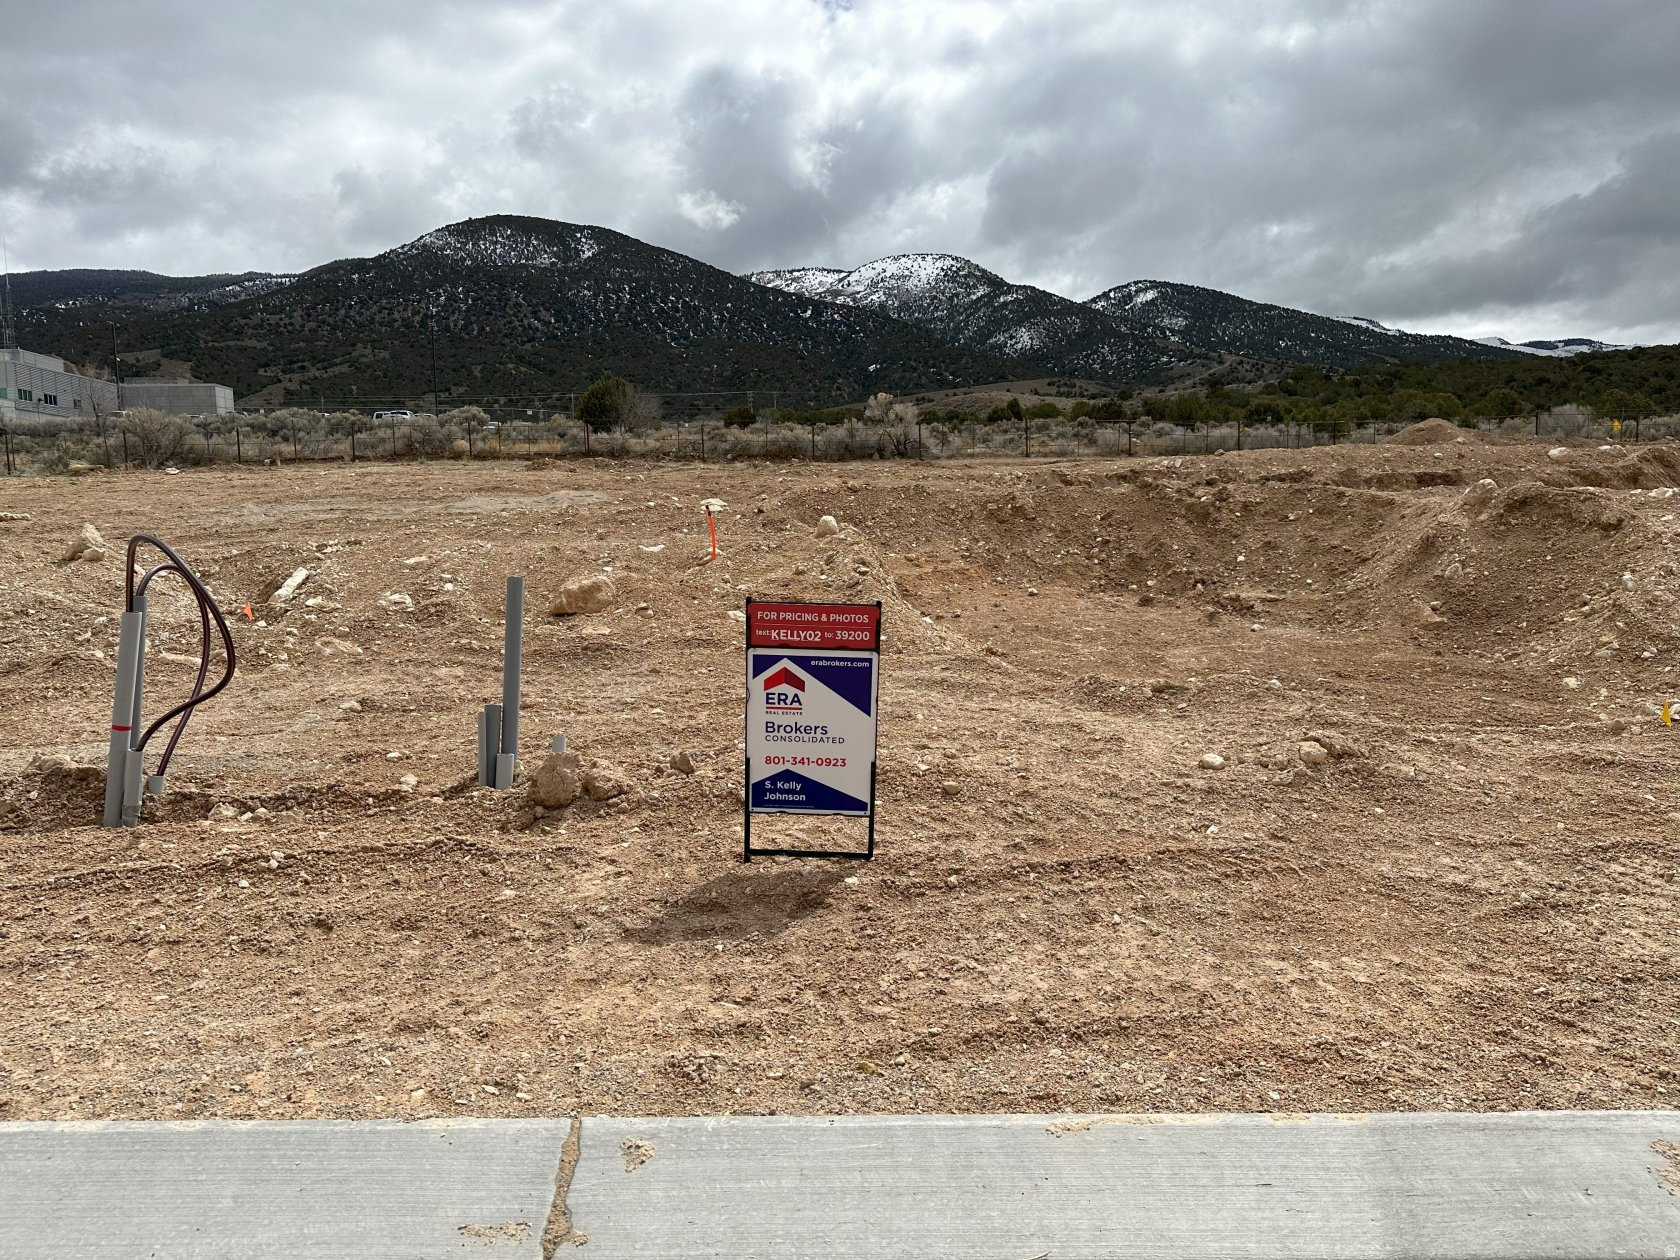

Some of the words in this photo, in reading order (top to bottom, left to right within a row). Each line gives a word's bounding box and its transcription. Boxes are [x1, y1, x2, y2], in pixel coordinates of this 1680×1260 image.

[757, 611, 777, 620] FOR
[779, 612, 819, 621] PRICING
[821, 613, 828, 622] &
[829, 613, 869, 623] PHOTOS
[771, 629, 822, 641] KELLY02
[835, 630, 870, 640] 39200
[811, 660, 870, 668] erabrokers.com
[765, 692, 803, 706] ERA
[765, 721, 828, 735] Brokers
[765, 735, 845, 744] CONSOLIDATED
[764, 756, 847, 767] 801-341-0923
[764, 781, 774, 789] S.
[777, 781, 802, 791] Kelly
[764, 792, 806, 801] Johnson
